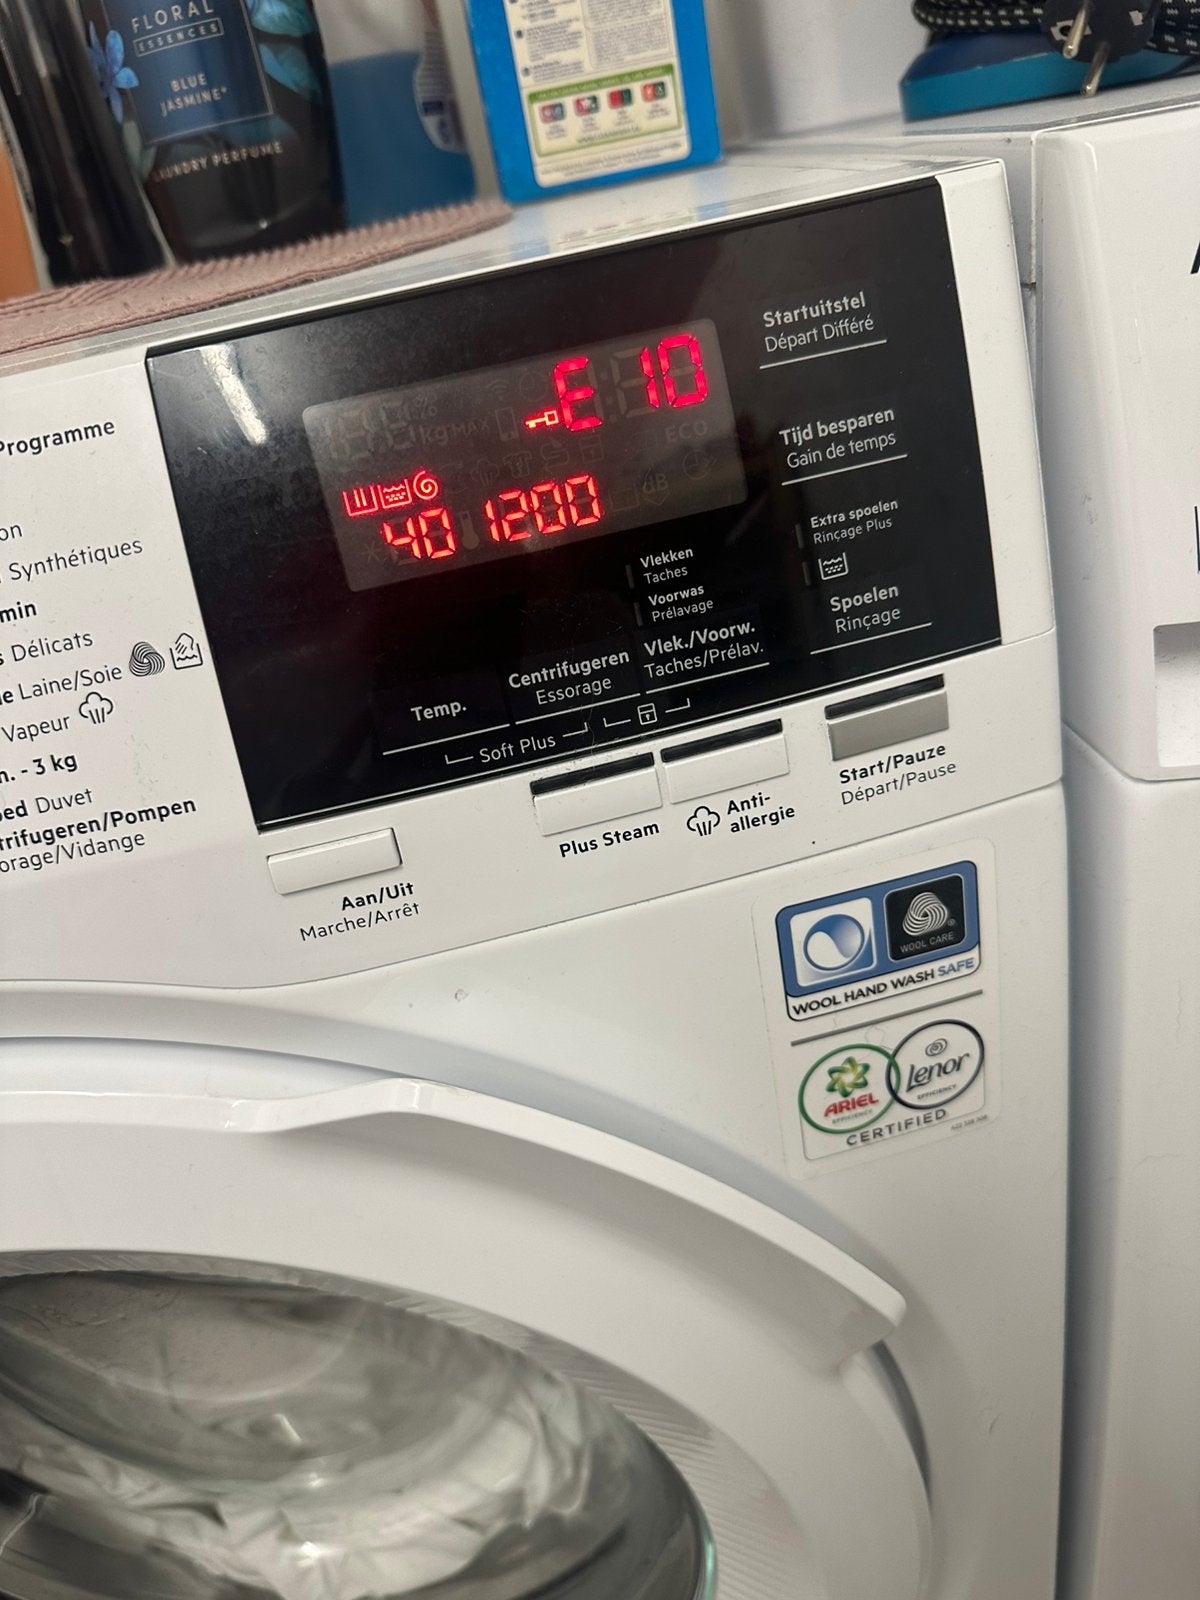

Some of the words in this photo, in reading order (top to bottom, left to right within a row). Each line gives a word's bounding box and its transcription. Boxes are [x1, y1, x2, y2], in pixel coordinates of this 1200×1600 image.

[131, 0, 214, 33] FLORAL
[139, 23, 218, 52] ESSENCES
[170, 73, 207, 92] BLUE
[763, 291, 866, 328] Startuitstel
[765, 327, 818, 353] Départ
[822, 313, 875, 341] Différé
[779, 424, 813, 447] Tijd
[817, 409, 895, 438] besparen
[787, 447, 822, 469] Gain
[826, 441, 845, 460] de
[848, 432, 896, 456] temps
[382, 507, 456, 560] 40
[484, 474, 602, 542] 1200
[810, 511, 846, 529] Extra
[849, 499, 898, 524] spoelen
[813, 525, 863, 545] Rinçage
[866, 516, 892, 532] Plus
[9, 540, 143, 581] Synthétiques
[640, 548, 693, 569] Vlekken
[644, 565, 688, 585] Taches
[648, 584, 705, 607] Voorwas
[829, 584, 899, 613] Spoelen
[652, 599, 714, 623] Prélavage
[835, 607, 901, 634] Rinçage
[11, 633, 93, 662] Délicats
[644, 621, 755, 657] Vlek./Voorw.
[508, 649, 630, 689] Centrifugeren
[644, 641, 764, 679] Taches/Prélav.
[19, 665, 123, 700] Laine/Soie
[536, 676, 613, 706] Essorage
[411, 701, 467, 723] Temp.
[1, 716, 70, 742] Vapeur
[479, 744, 515, 764] Soft
[520, 734, 556, 754] Plus
[839, 743, 946, 784] Start/Pauze
[32, 757, 46, 775] 3
[50, 754, 78, 773] kg
[841, 762, 957, 806] Départ/Pause
[35, 788, 92, 814] Duvet
[726, 791, 771, 815] Anti-
[730, 804, 795, 834] allergie
[559, 836, 598, 858] Plus
[602, 821, 659, 848] Steam
[341, 882, 414, 911] Aan/Uit
[300, 902, 420, 941] Marche/Arrêt
[900, 939, 927, 953] WOOL
[929, 931, 955, 945] CARE
[792, 994, 841, 1015] WOOL
[844, 983, 887, 1002] HAND
[891, 970, 935, 989] WASH
[937, 957, 975, 977] SAFE
[906, 1052, 970, 1093] Lenor
[824, 1092, 879, 1118] ARIEL
[846, 1108, 947, 1146] CERTIFIED
